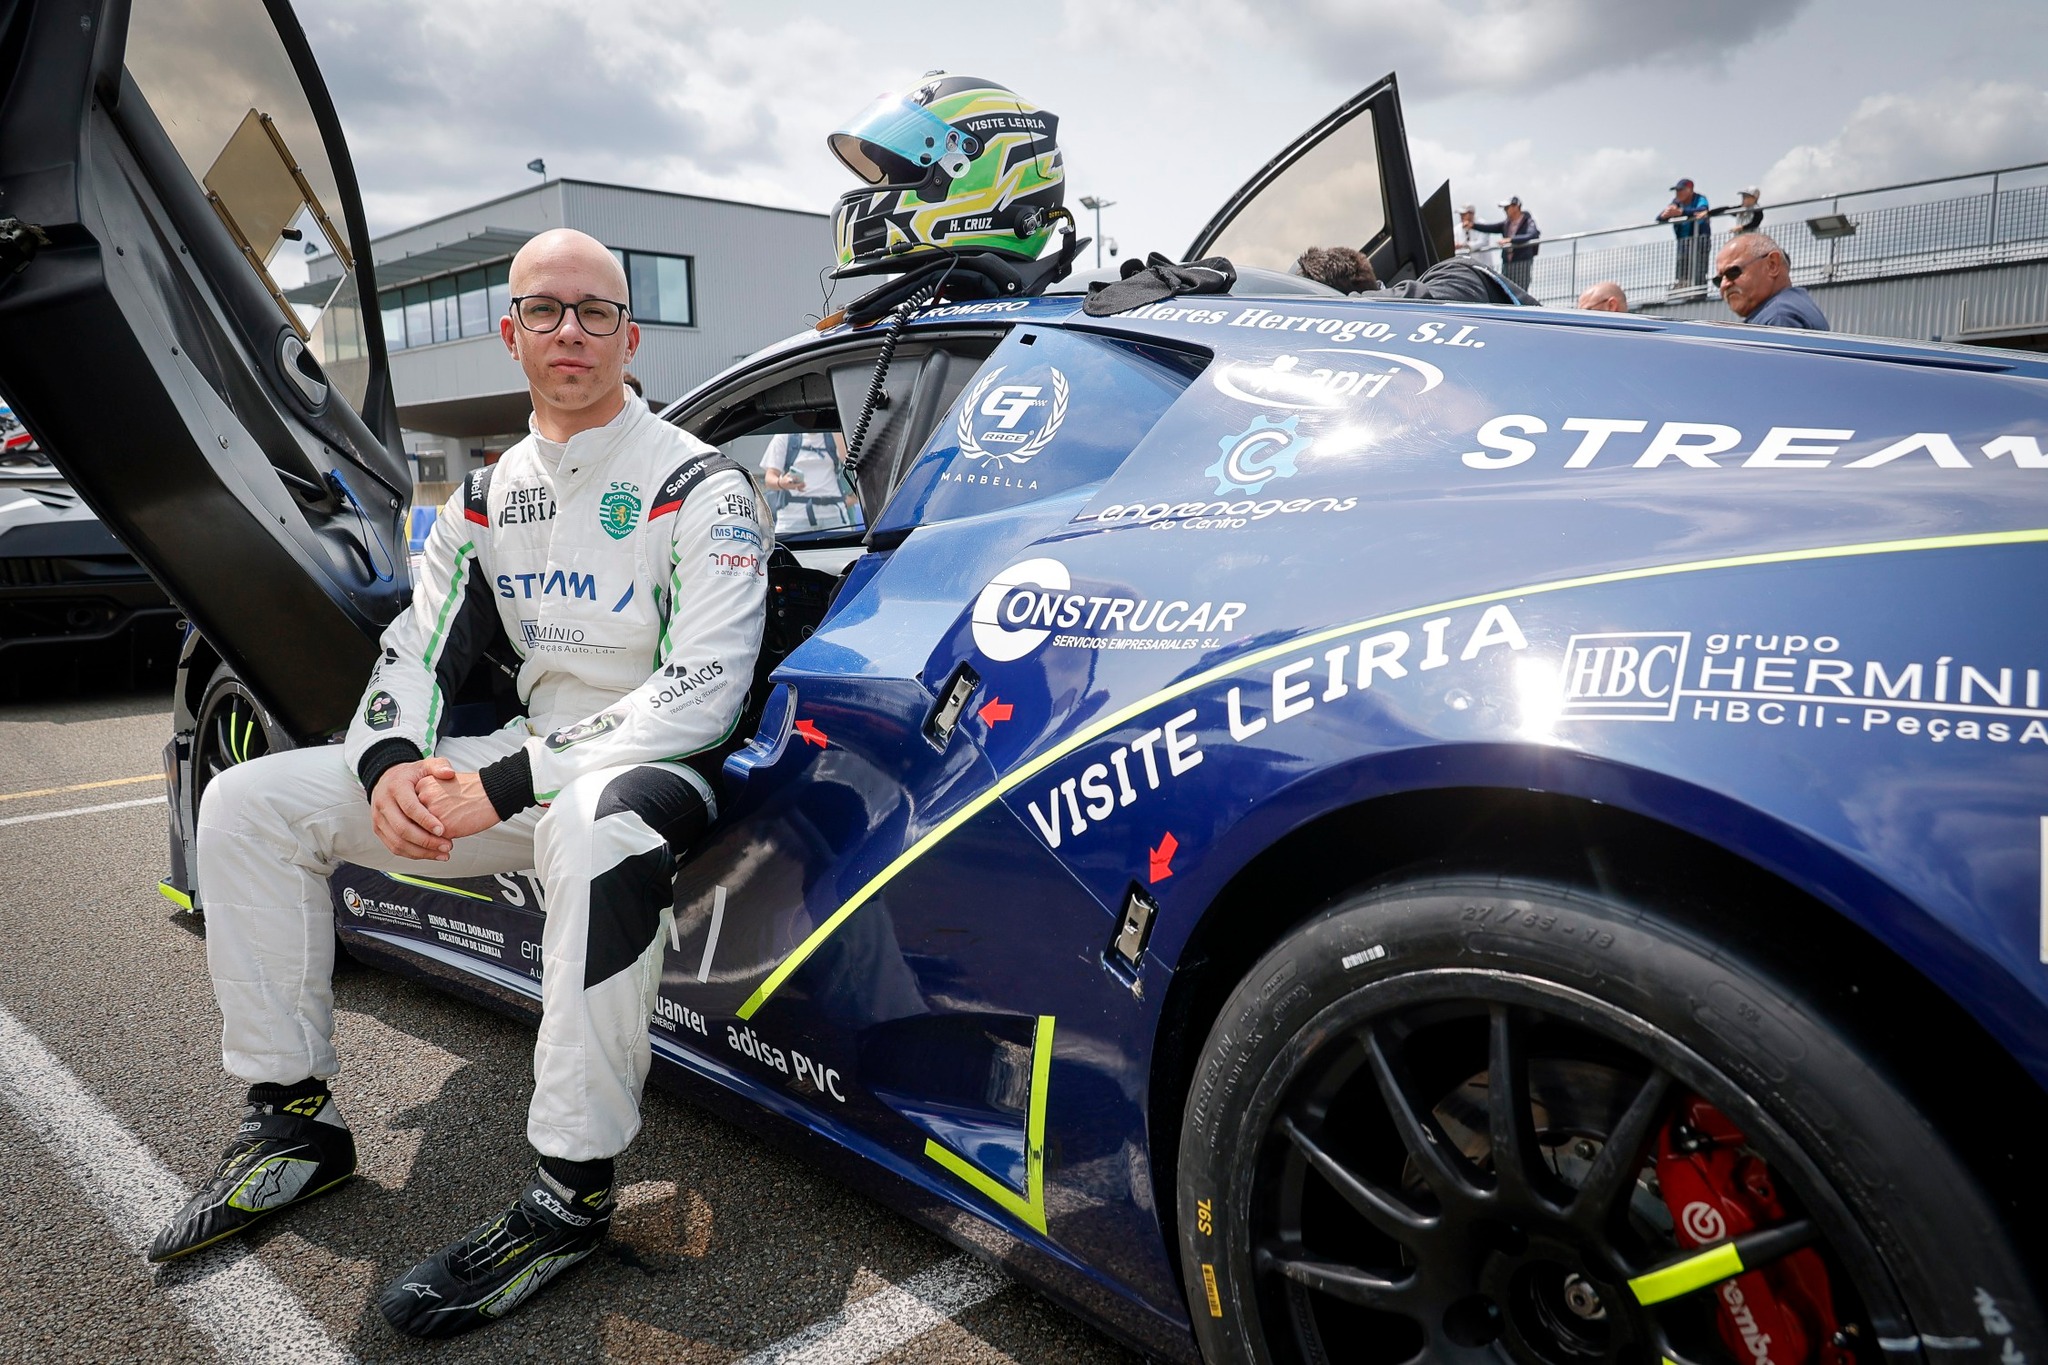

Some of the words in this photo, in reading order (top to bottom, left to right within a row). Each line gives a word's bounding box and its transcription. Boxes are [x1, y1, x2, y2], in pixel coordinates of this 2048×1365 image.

[967, 118, 1005, 132] VISITE
[1008, 117, 1045, 130] LEIRIA
[950, 220, 961, 232] H.
[964, 217, 993, 231] CRUZ
[1111, 303, 1229, 325] lleres
[1228, 308, 1397, 342] Herrogo,
[1407, 321, 1486, 348] S.L.
[984, 433, 1025, 443] RACE
[610, 481, 639, 493] SCP
[666, 460, 708, 497] Sabelt
[941, 472, 1038, 490] MARBELLA
[605, 494, 639, 509] SPORTING
[1097, 497, 1358, 524] engrenagens
[603, 523, 633, 535] PORTUGAL
[715, 528, 731, 537] MS
[1150, 519, 1177, 530] do
[1182, 516, 1247, 530] Centro
[1053, 635, 1107, 649] SERVICIOS
[1108, 638, 1199, 651] EMPRESARIALES
[1201, 638, 1221, 649] S.L.
[1706, 633, 1840, 656] grupo
[1569, 643, 1679, 699] HBC
[649, 661, 724, 709] SOLANCIS
[1699, 656, 2041, 709] HERMÍNI
[670, 700, 694, 715] TRADITION
[694, 696, 704, 705] &
[1027, 708, 1205, 849] VISITE
[1227, 603, 1529, 743] LEIRIA
[379, 901, 420, 920] CHOZA
[428, 914, 449, 928] HNOS.
[449, 919, 467, 933] RUIZ
[467, 924, 504, 944] DORANTES
[655, 994, 708, 1037] uantel
[727, 1025, 788, 1075] adisa
[791, 1050, 846, 1103] PVC
[1192, 1033, 1233, 1134] MICHELIN
